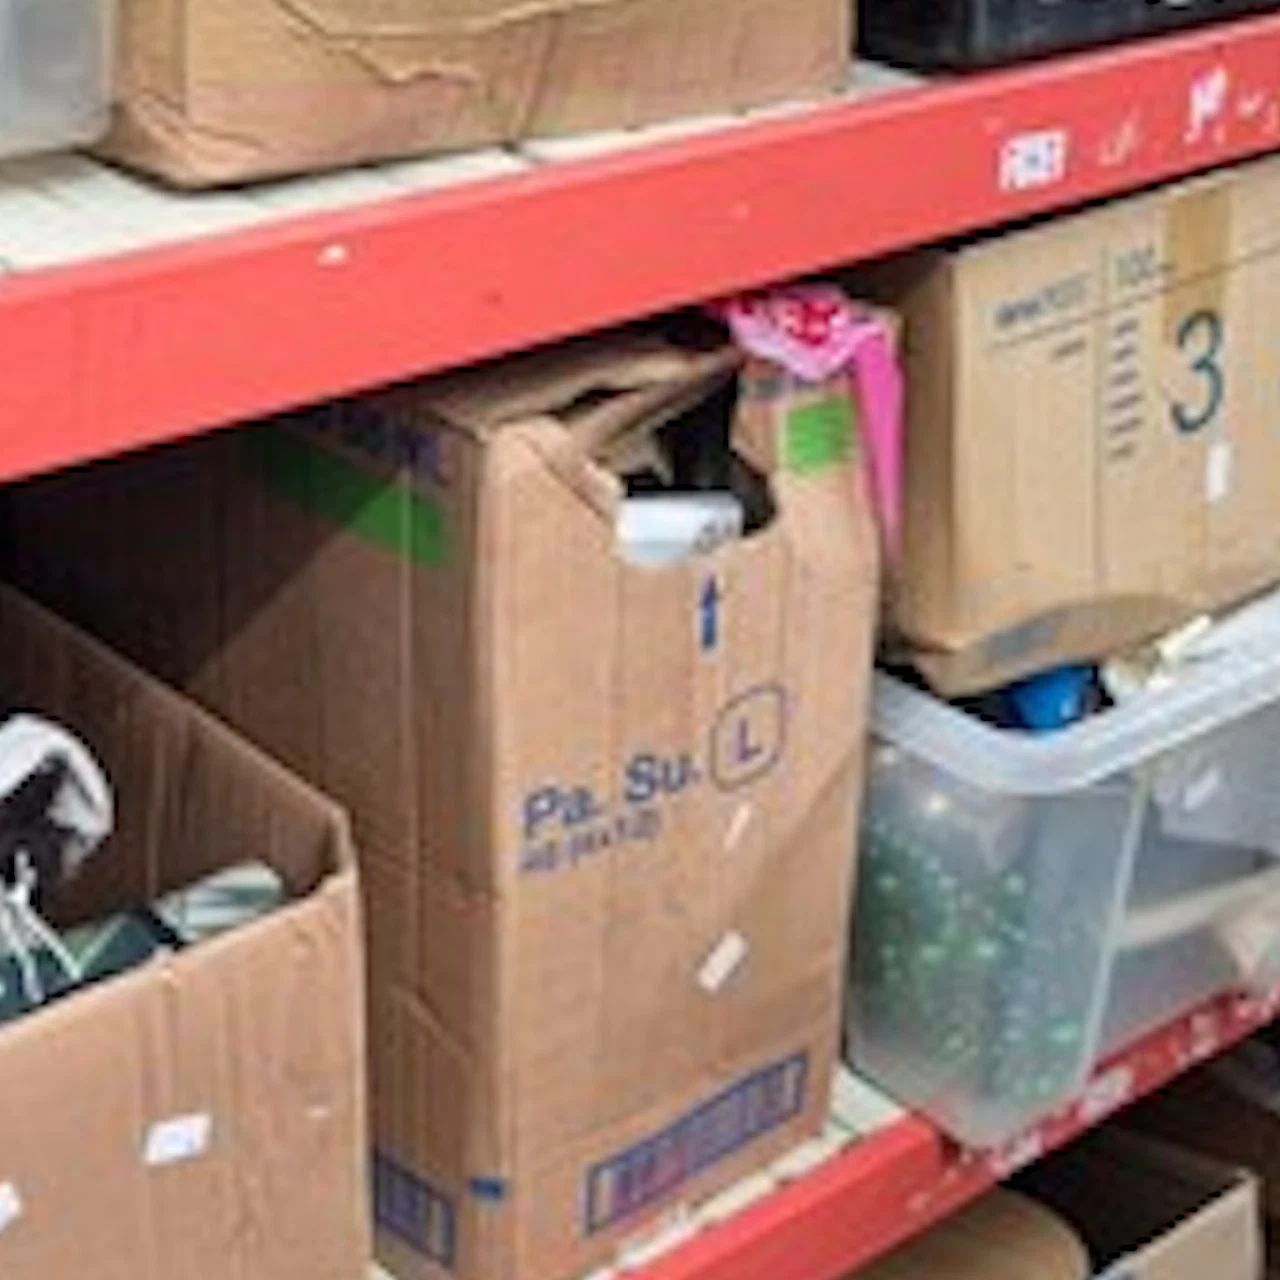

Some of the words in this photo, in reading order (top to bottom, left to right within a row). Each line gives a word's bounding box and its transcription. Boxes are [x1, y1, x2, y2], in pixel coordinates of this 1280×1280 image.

[1171, 307, 1226, 433] 3
[523, 785, 602, 838] Pa.
[624, 752, 702, 803] Su.
[735, 716, 762, 762] L
